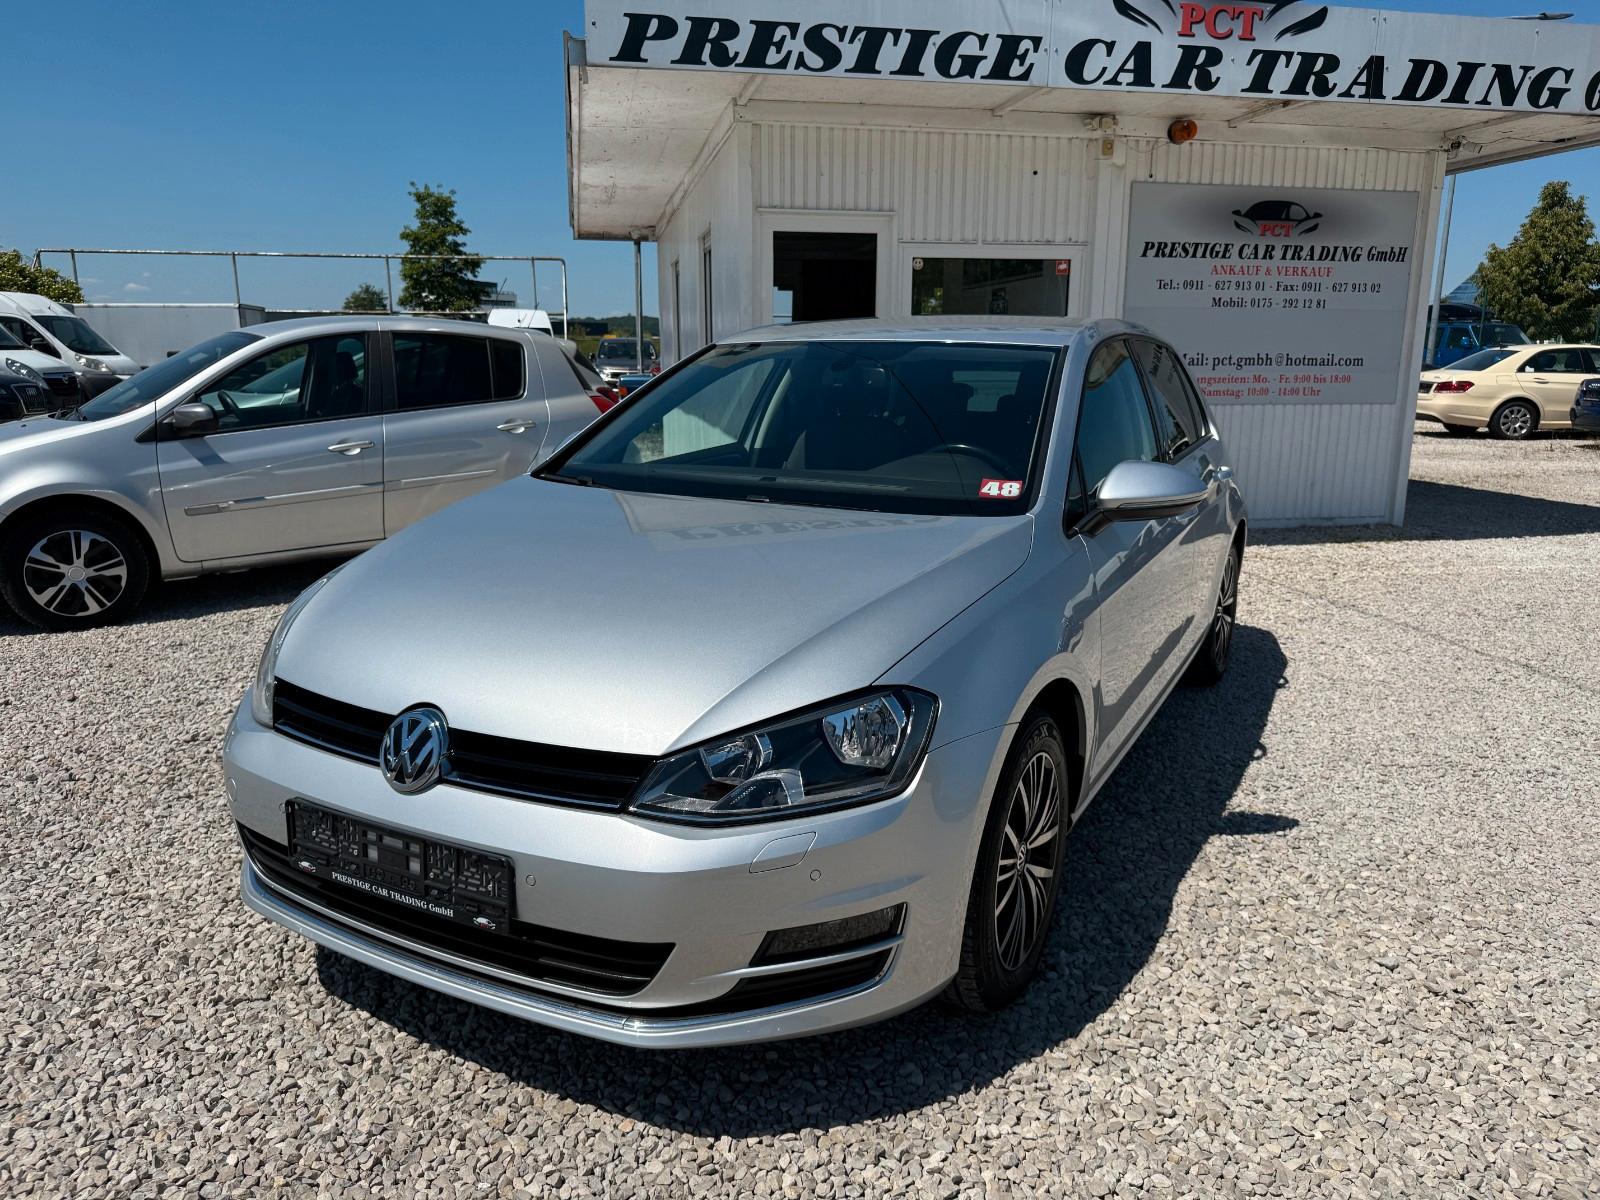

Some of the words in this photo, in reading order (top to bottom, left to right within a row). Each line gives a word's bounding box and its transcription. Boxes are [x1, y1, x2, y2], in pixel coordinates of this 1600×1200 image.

[1177, 3, 1264, 41] PCT
[609, 12, 1043, 82] PRESTIGE
[1064, 37, 1224, 92] CAR
[1238, 48, 1575, 110] TRADING
[1259, 223, 1295, 237] PCT
[1140, 241, 1234, 259] PRESTIGE
[1238, 243, 1276, 260] CAR
[1280, 244, 1363, 262] TRADING
[1366, 246, 1408, 263] GmbH
[1211, 264, 1262, 276] ANKAUF
[1264, 266, 1272, 276] &
[1276, 266, 1334, 278] VERKAUF
[1156, 279, 1180, 290] Tel.:
[1183, 280, 1204, 290] 0911
[1215, 281, 1232, 291] 627
[1235, 281, 1252, 291] 913
[1255, 282, 1266, 292] 01
[1275, 281, 1299, 292] Fax:
[1302, 282, 1322, 292] 0911
[1332, 283, 1349, 293] 627
[1351, 283, 1368, 293] 913
[1371, 283, 1381, 294] 02
[1211, 297, 1248, 308] Mobil:
[1250, 298, 1273, 308] 0175
[1282, 299, 1300, 309] 292
[1303, 299, 1313, 309] 12
[1315, 299, 1326, 309] 81
[1182, 353, 1209, 366] ail:
[1211, 353, 1364, 371] pct.gmbh@hotmail.com
[1252, 374, 1271, 384] Mo.
[1293, 374, 1312, 384] 9:00
[1313, 374, 1327, 384] bis
[1329, 374, 1352, 385] 18:00
[1247, 387, 1270, 397] 10:00
[1302, 387, 1321, 397] Uhr
[981, 481, 1020, 497] 48
[331, 871, 371, 891] PRESTIGE
[372, 885, 389, 897] CAR
[389, 890, 428, 909] TRADING
[428, 903, 455, 918] GmbH
